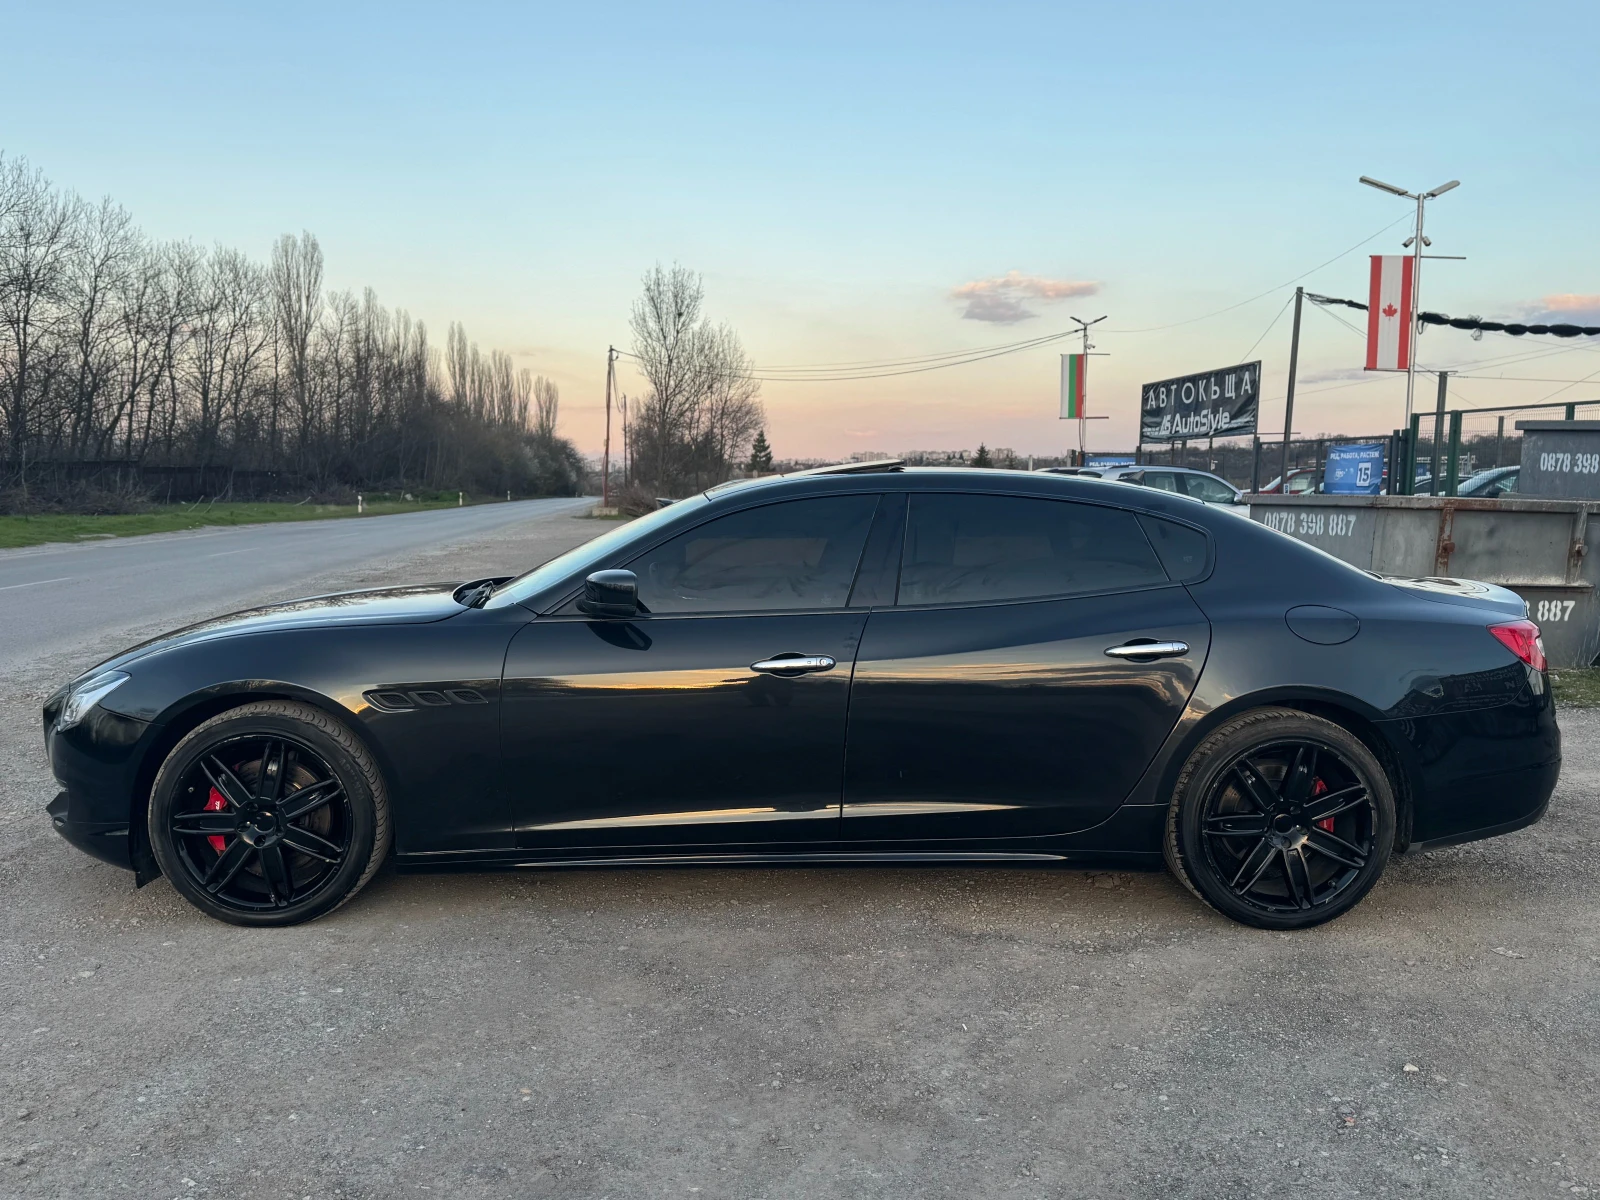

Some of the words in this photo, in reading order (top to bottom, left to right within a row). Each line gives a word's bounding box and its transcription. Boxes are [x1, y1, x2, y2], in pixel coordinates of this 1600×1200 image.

[1147, 371, 1252, 410] АВТОКЪЩА
[1172, 407, 1230, 436] AutoStyle
[1358, 467, 1370, 483] 15
[1540, 452, 1571, 473] 0878
[1573, 453, 1600, 474] 398
[1264, 511, 1295, 534] 0878
[1299, 512, 1325, 536] 398
[1328, 513, 1357, 537] 887
[1537, 599, 1576, 622] 887
